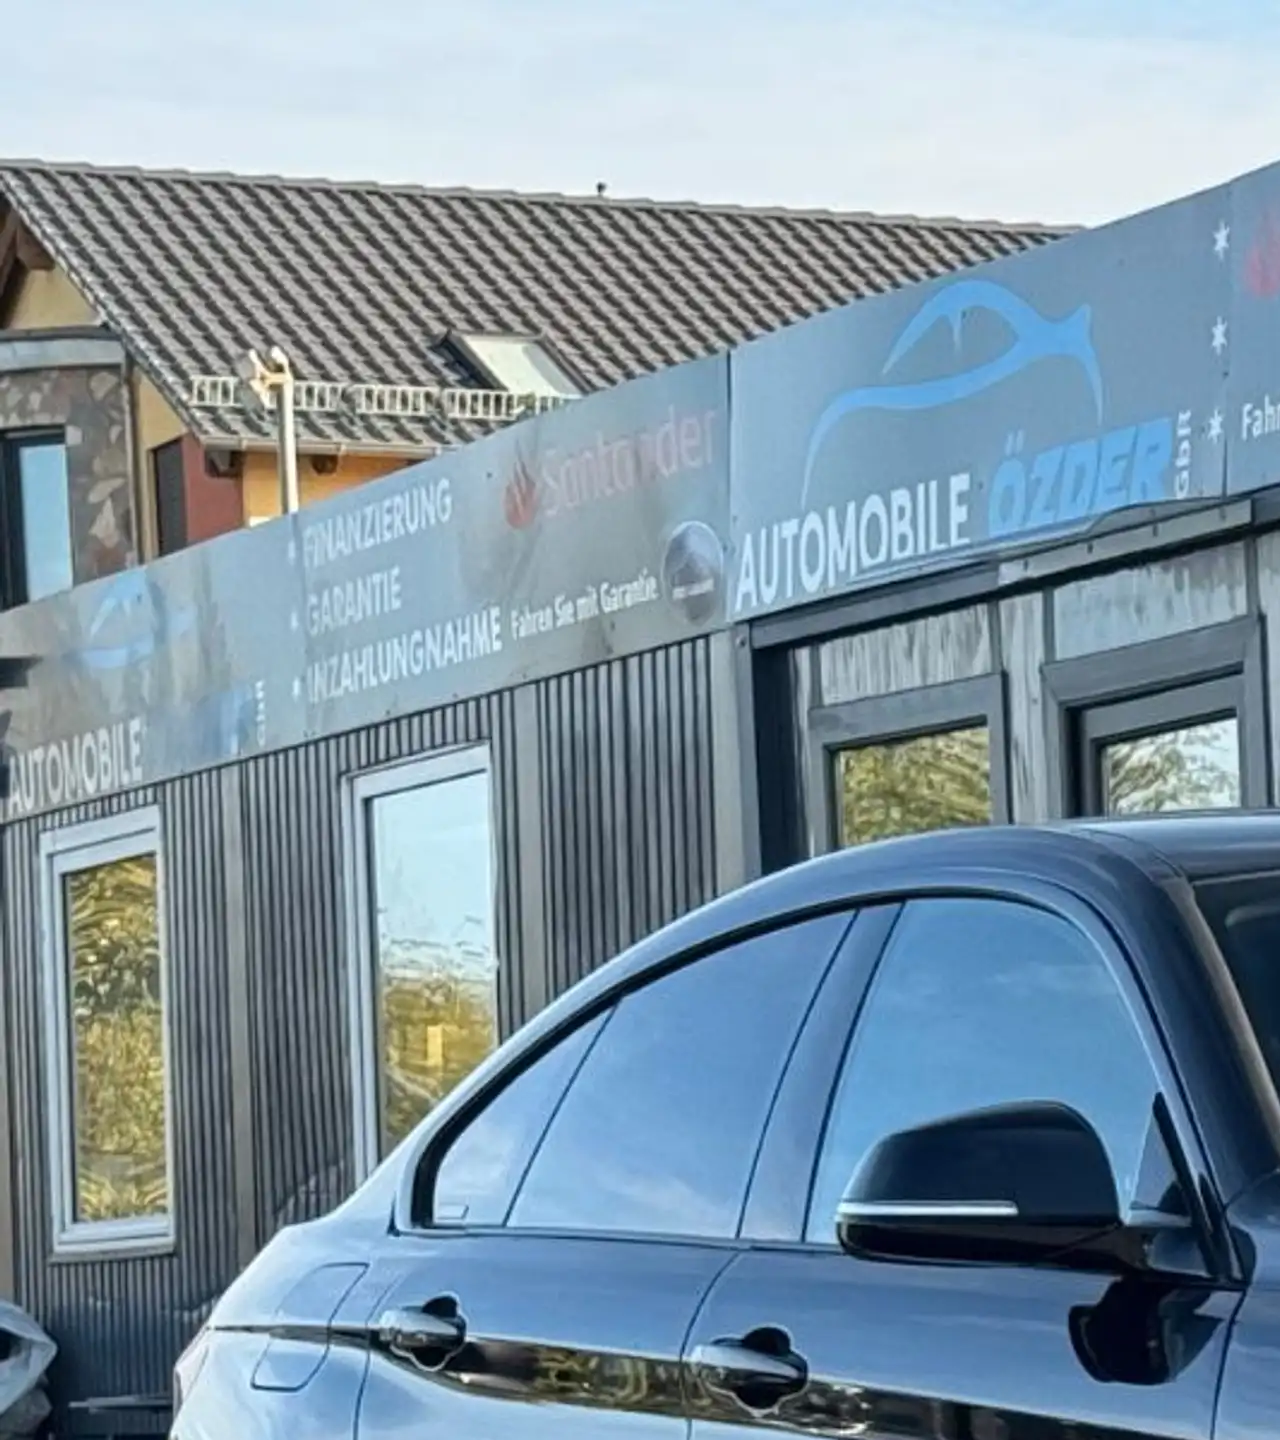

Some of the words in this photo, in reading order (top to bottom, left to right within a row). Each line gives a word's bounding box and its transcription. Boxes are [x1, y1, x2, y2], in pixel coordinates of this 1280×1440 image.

[302, 476, 452, 569] FINANZIERUNG
[734, 471, 971, 611] AUTOMOBILE
[988, 417, 1174, 540] ÖZDER
[306, 565, 402, 637] GARANTIE
[305, 605, 503, 704] INZAHLUNGNAHME
[8, 716, 143, 817] AUTOMOBILE
